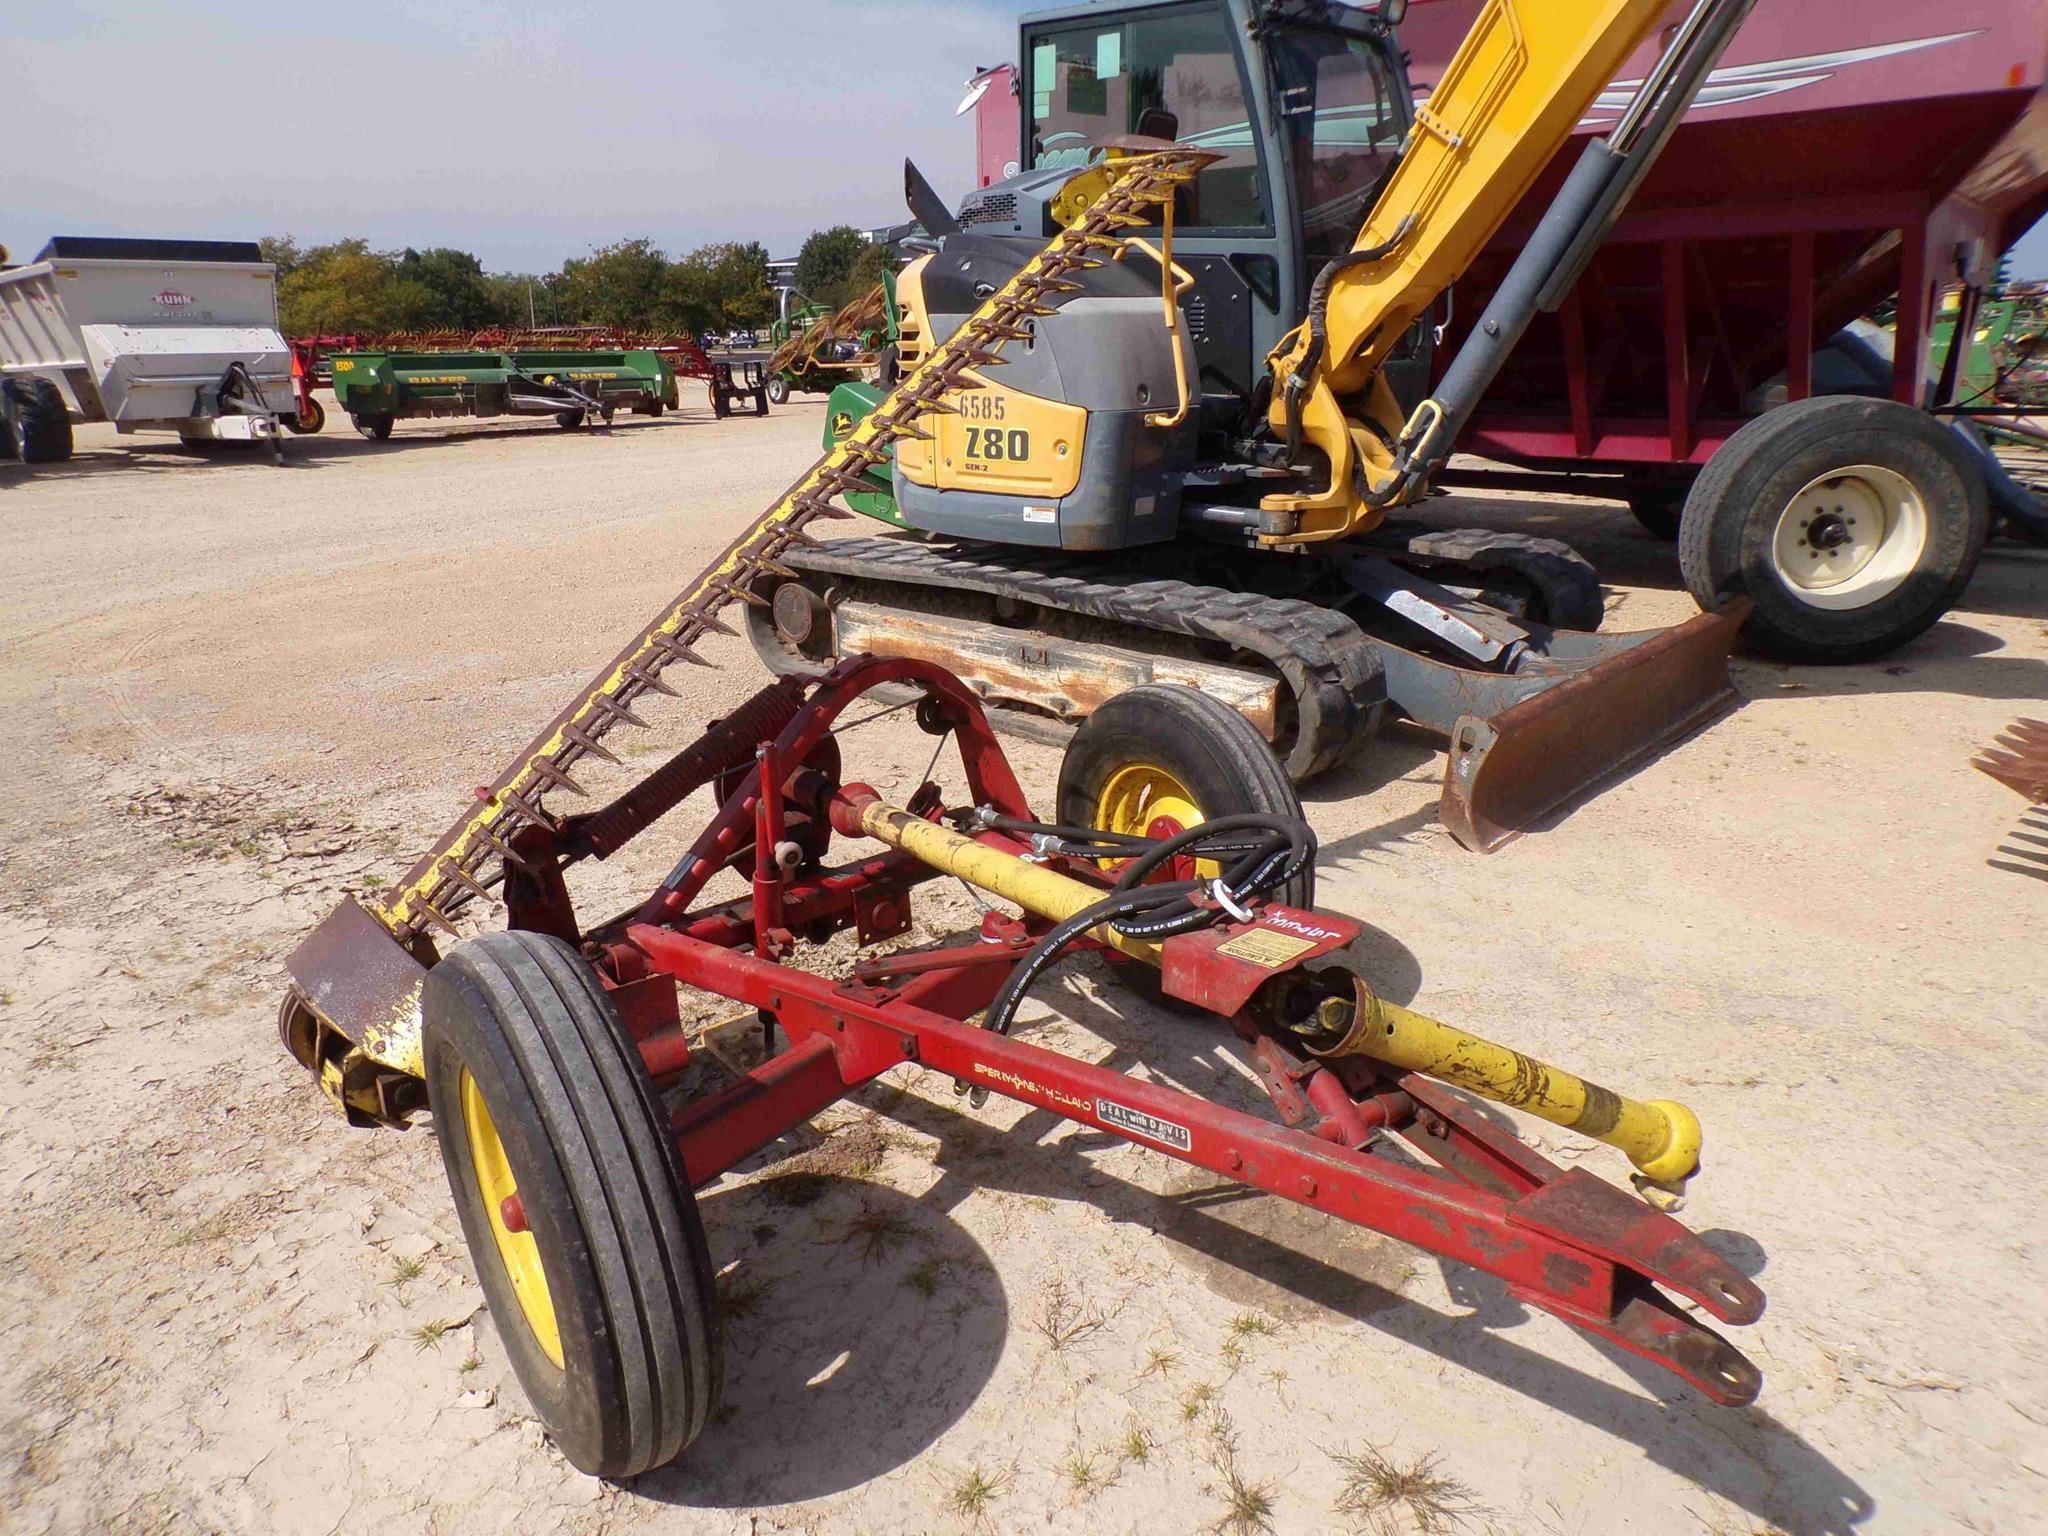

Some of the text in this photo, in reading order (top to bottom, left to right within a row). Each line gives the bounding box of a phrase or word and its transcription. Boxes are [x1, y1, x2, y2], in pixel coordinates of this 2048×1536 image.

[155, 295, 192, 305] KUHN
[960, 394, 1005, 420] 6585
[965, 426, 1029, 462] Z80
[1100, 1102, 1128, 1120] DEAL
[1129, 1113, 1148, 1127] with
[1149, 1119, 1186, 1140] DAVIS
